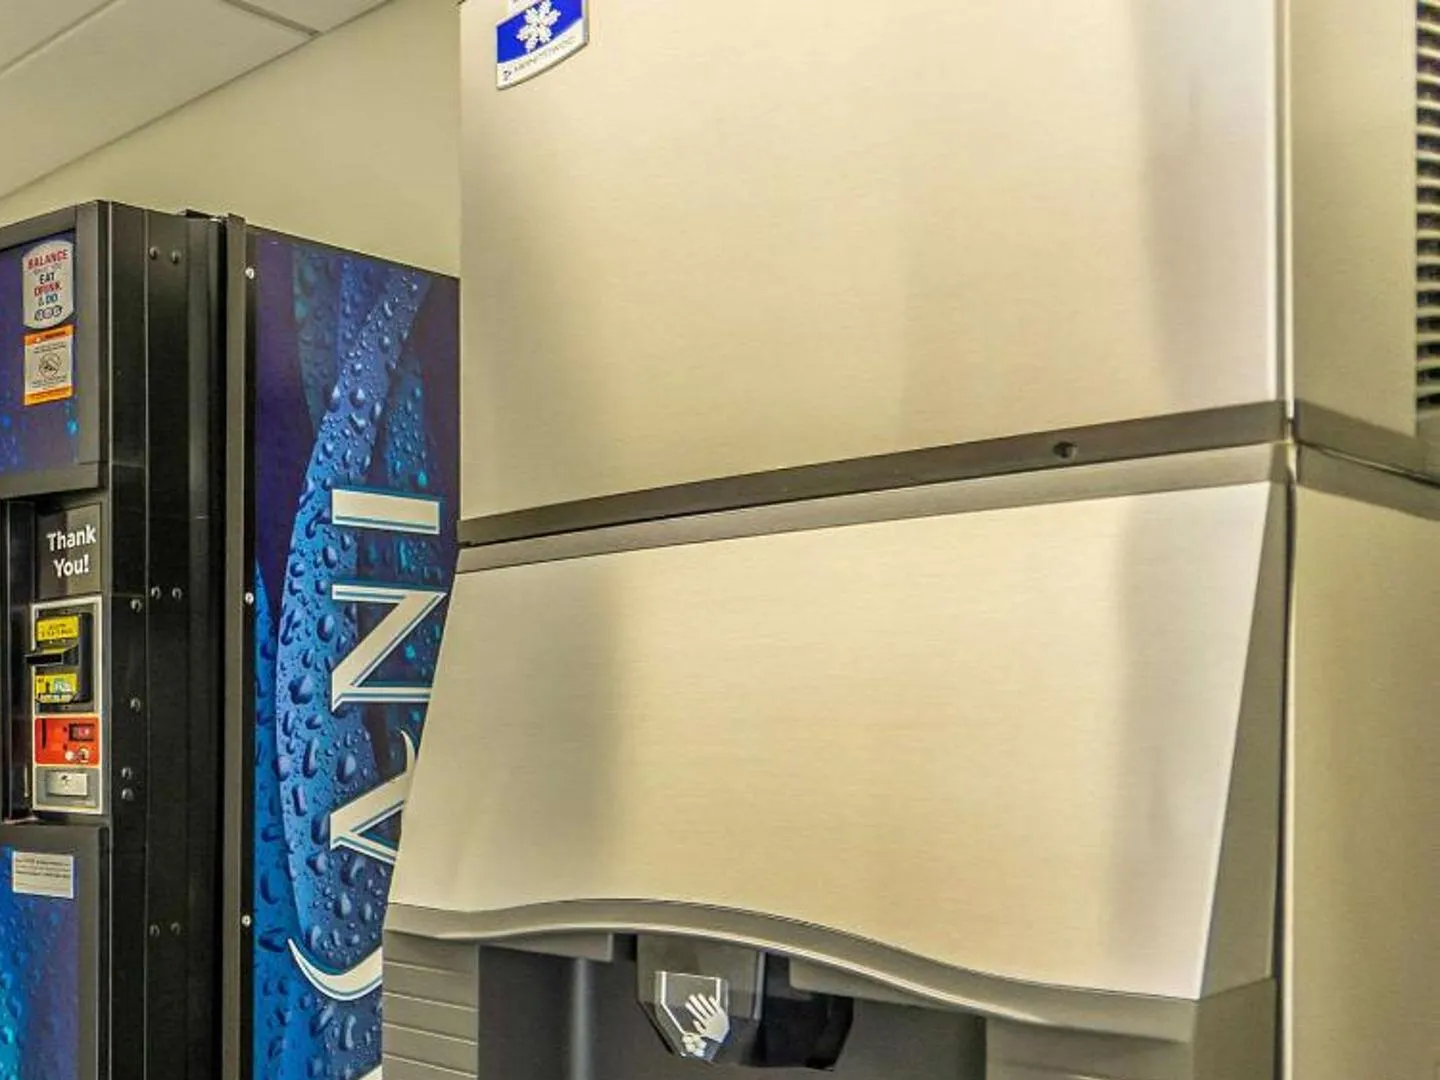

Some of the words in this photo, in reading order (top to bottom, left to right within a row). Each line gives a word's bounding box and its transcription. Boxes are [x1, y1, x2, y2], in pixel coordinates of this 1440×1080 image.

[27, 248, 69, 270] BALANCE
[40, 271, 55, 285] EAT
[46, 525, 97, 552] Thank
[53, 554, 89, 578] You!
